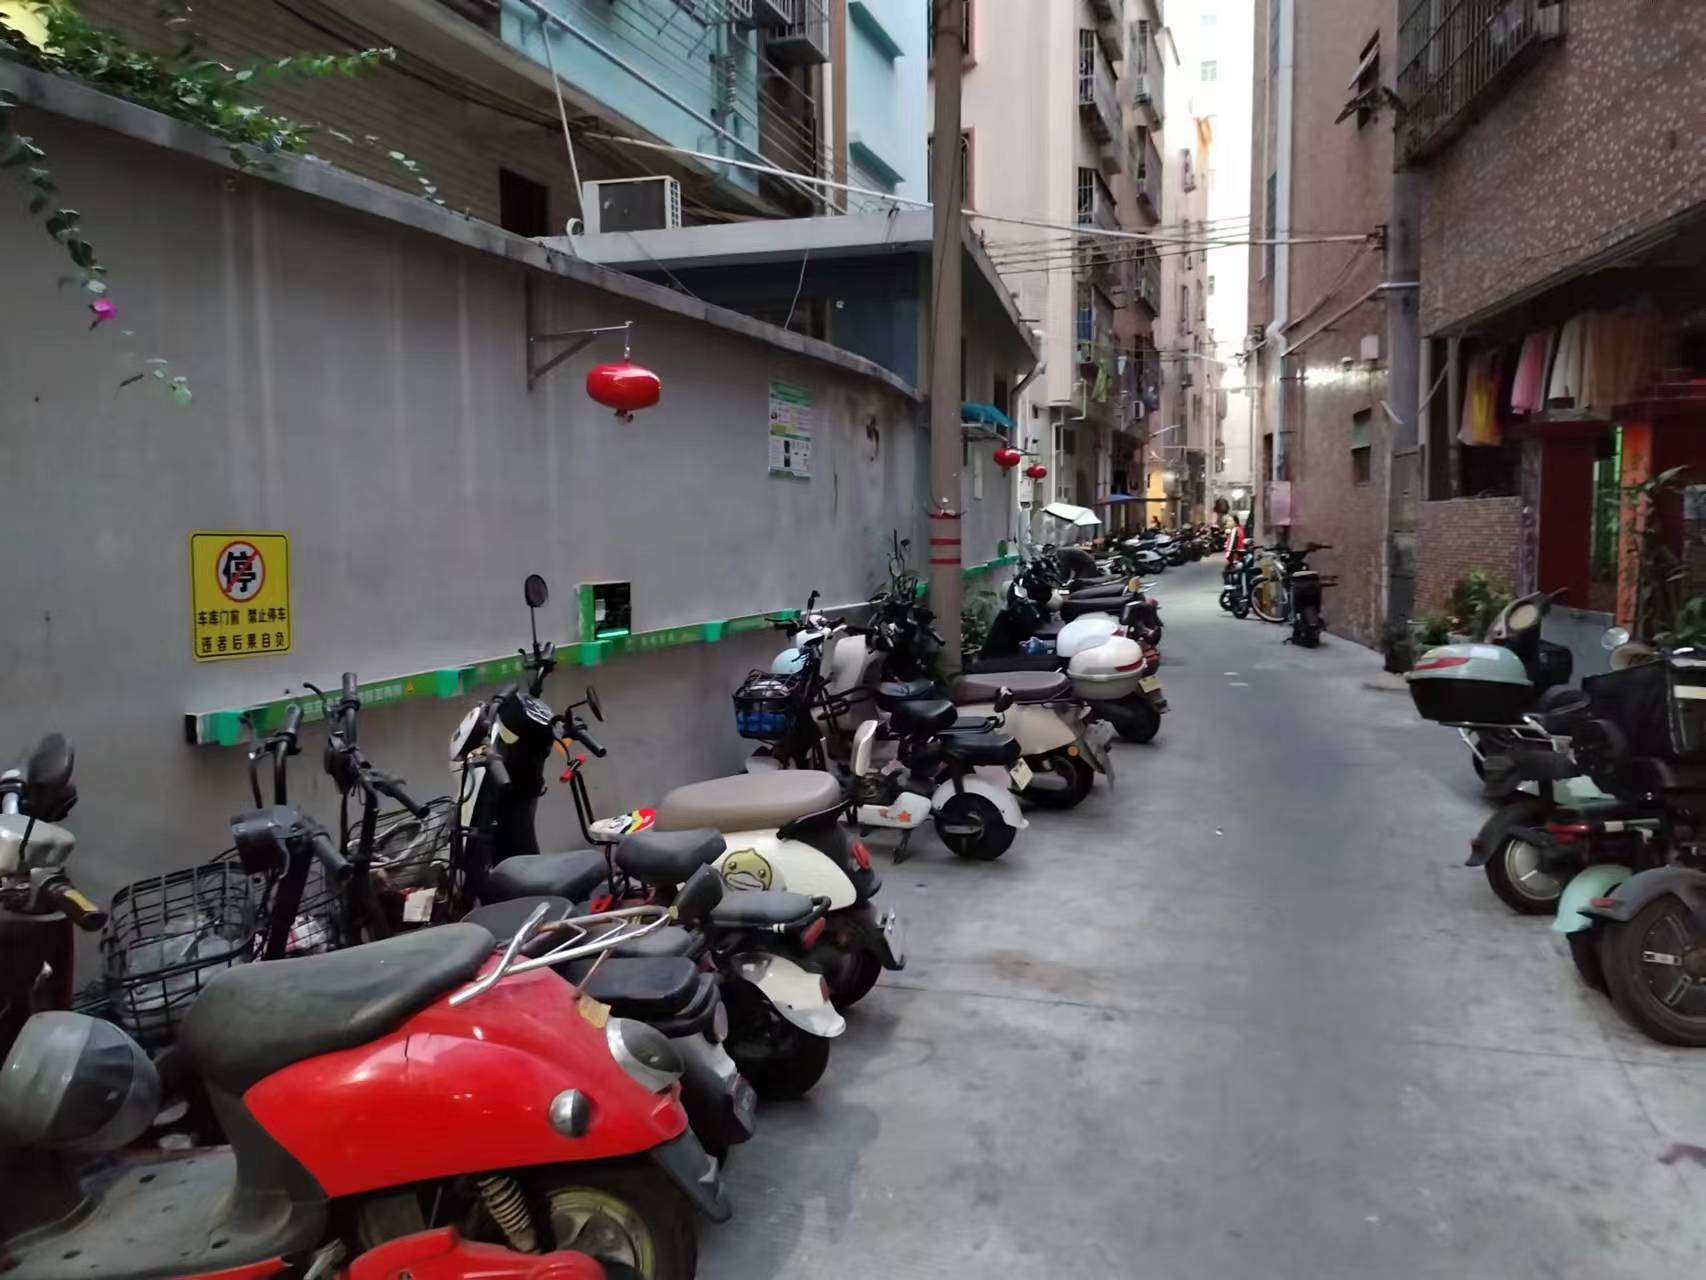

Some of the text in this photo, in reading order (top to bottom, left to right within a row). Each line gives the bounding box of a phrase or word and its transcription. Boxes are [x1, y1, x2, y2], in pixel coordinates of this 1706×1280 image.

[222, 551, 257, 592] 停
[198, 607, 287, 626] 车库门前 禁止停车
[201, 631, 284, 653] 违者后果自负
